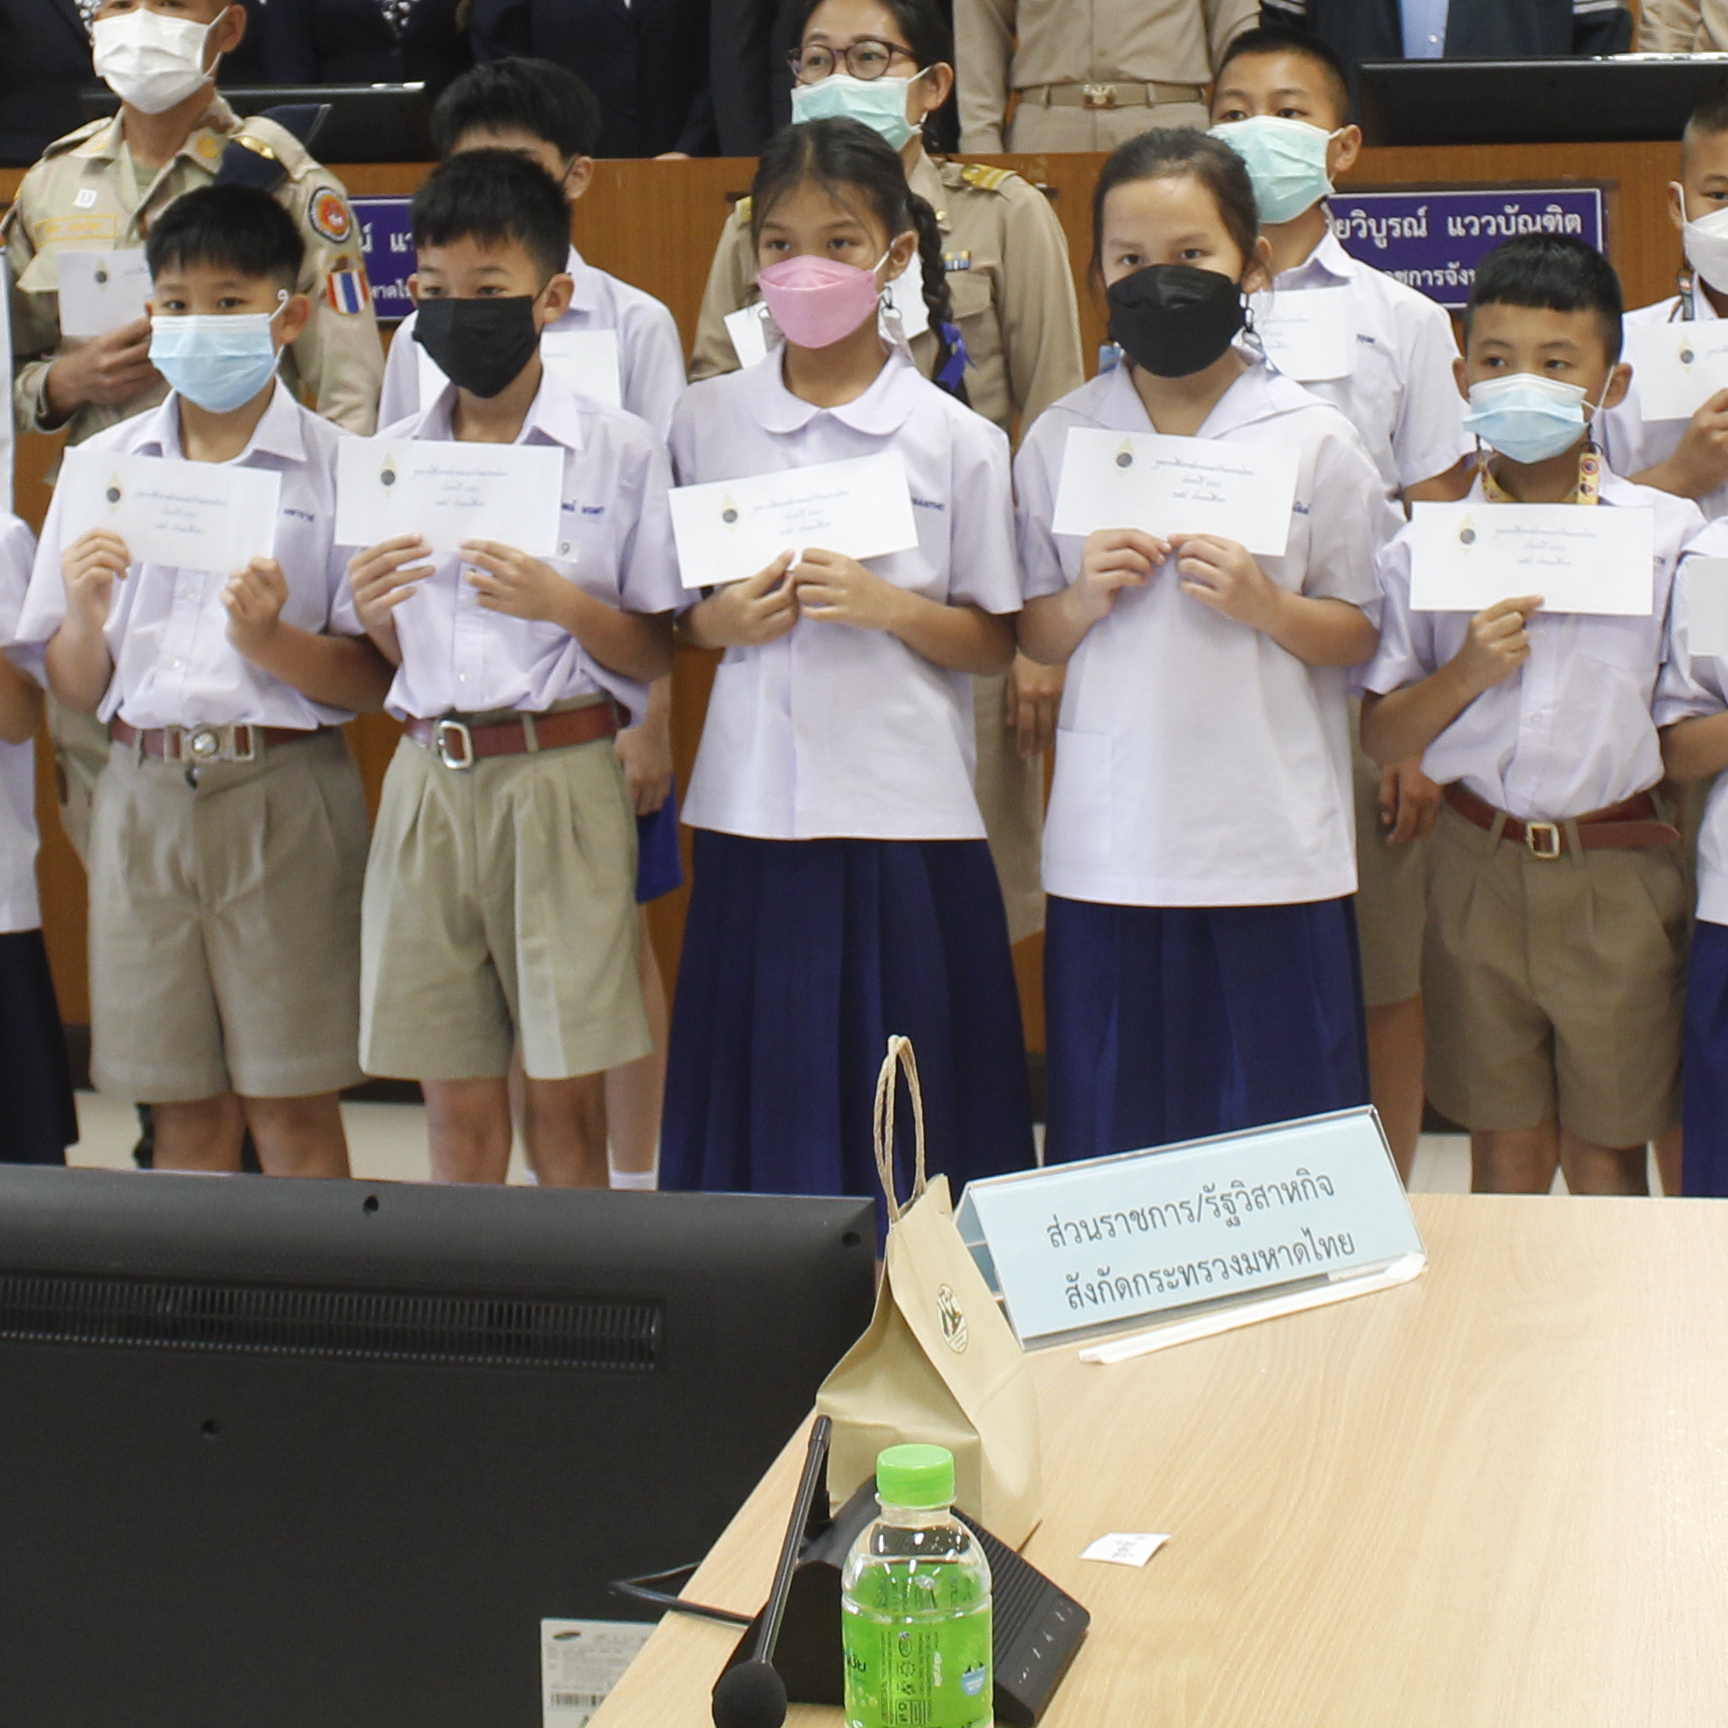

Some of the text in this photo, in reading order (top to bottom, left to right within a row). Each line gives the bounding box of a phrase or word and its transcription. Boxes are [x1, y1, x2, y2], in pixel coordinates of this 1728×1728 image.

[1327, 204, 1429, 249] ยวิบูรณ์
[1046, 1167, 1335, 1249] ส่วนราชการ/รัฐวิสาหกิจ
[1064, 1226, 1357, 1311] สังกัดกระทรวงมหาดไทย
